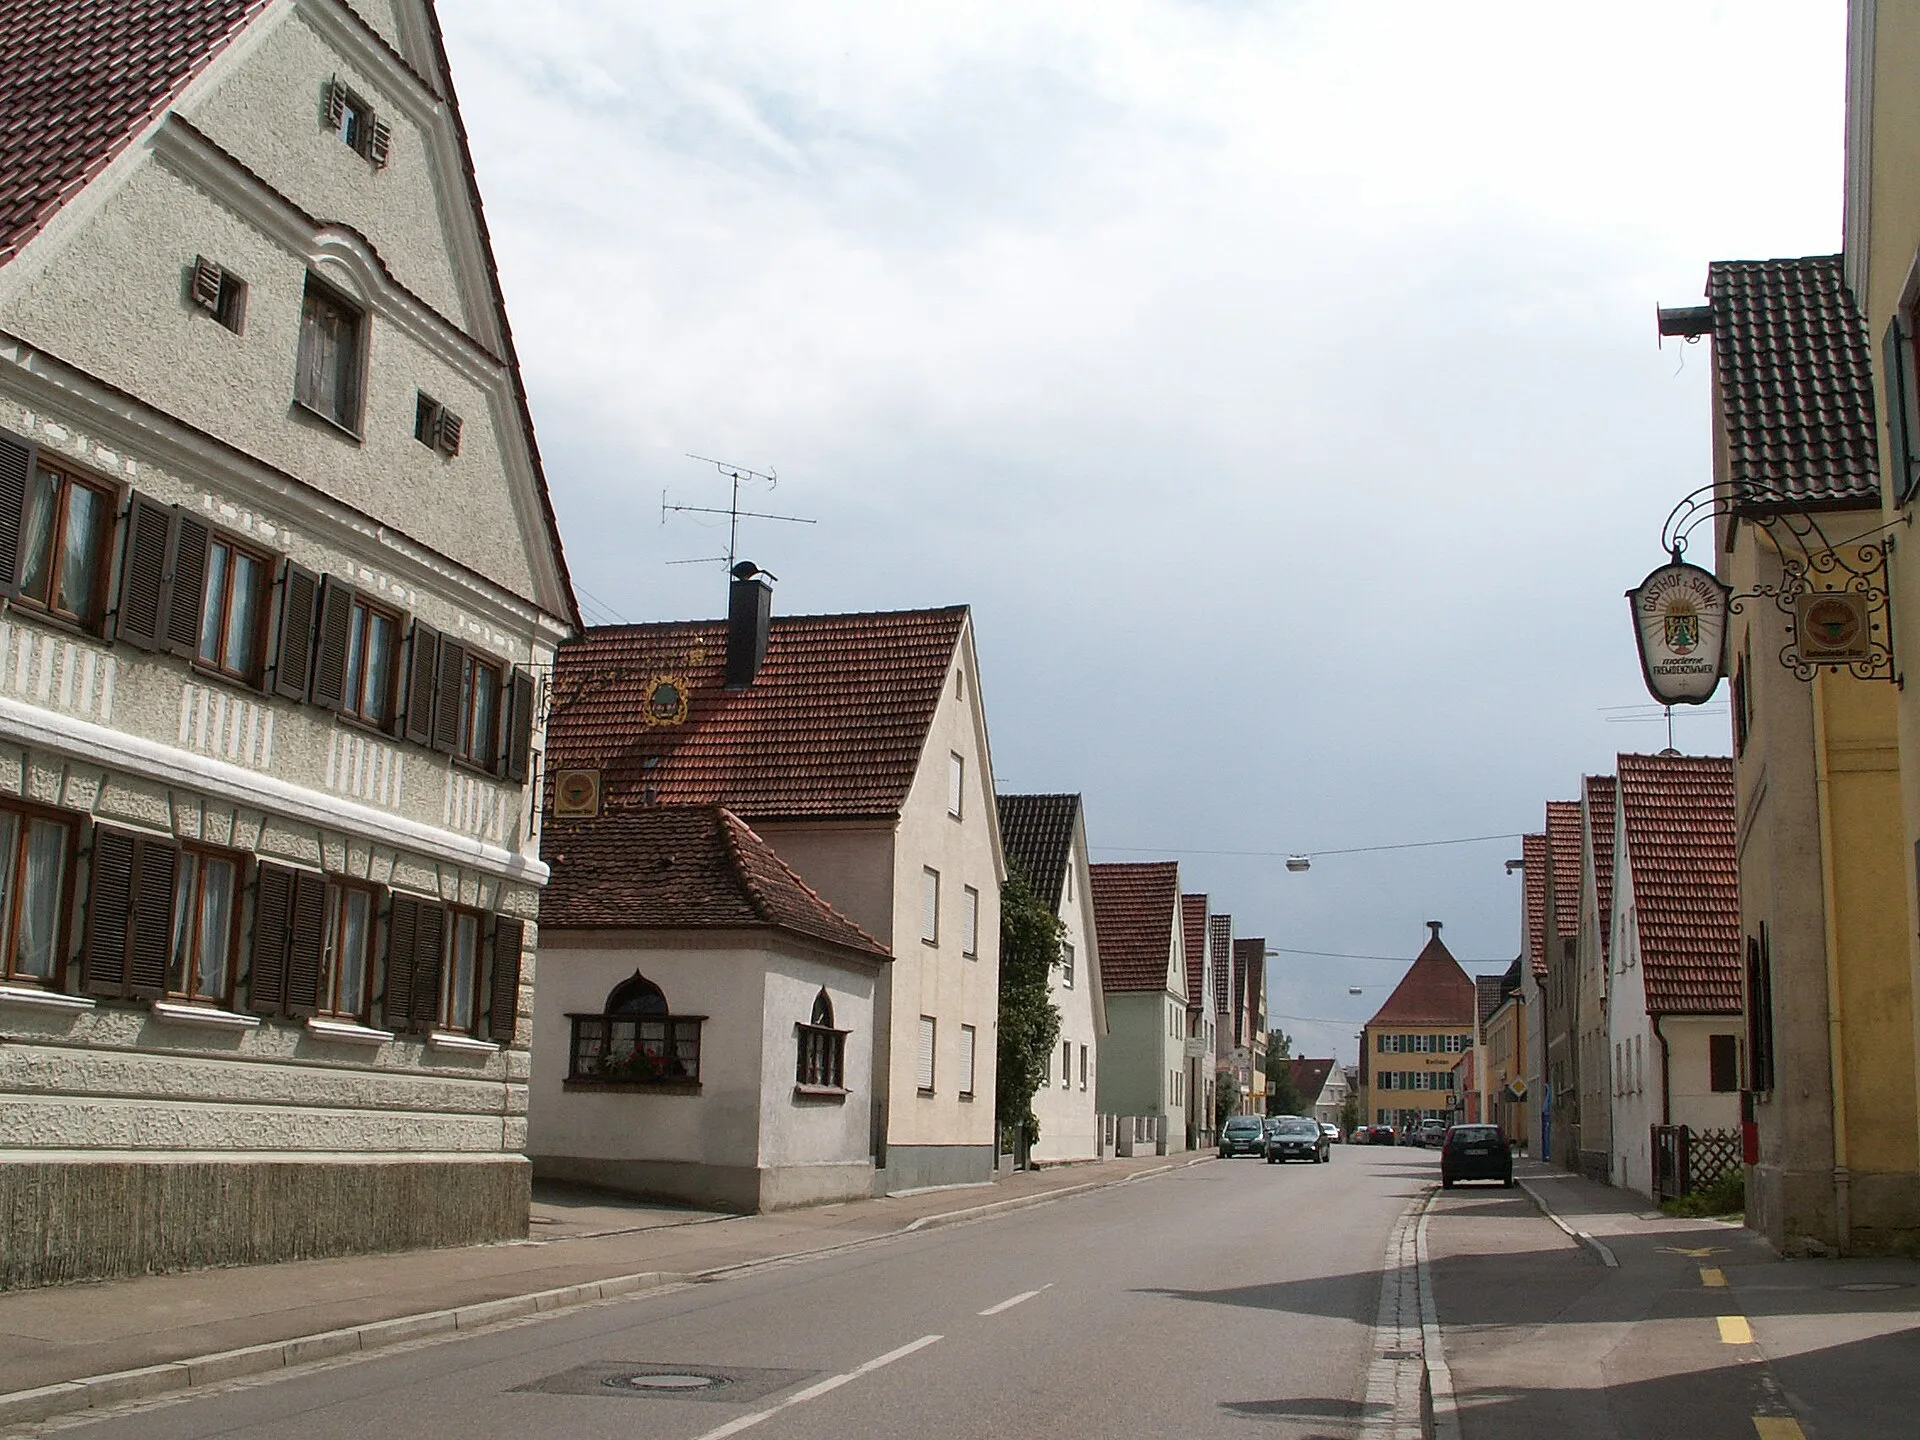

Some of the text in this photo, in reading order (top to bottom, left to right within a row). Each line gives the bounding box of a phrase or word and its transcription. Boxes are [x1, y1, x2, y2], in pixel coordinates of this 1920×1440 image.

[1643, 574, 1682, 612] GASTHOF
[1690, 577, 1718, 609] SONNE
[1662, 656, 1704, 665] moderne
